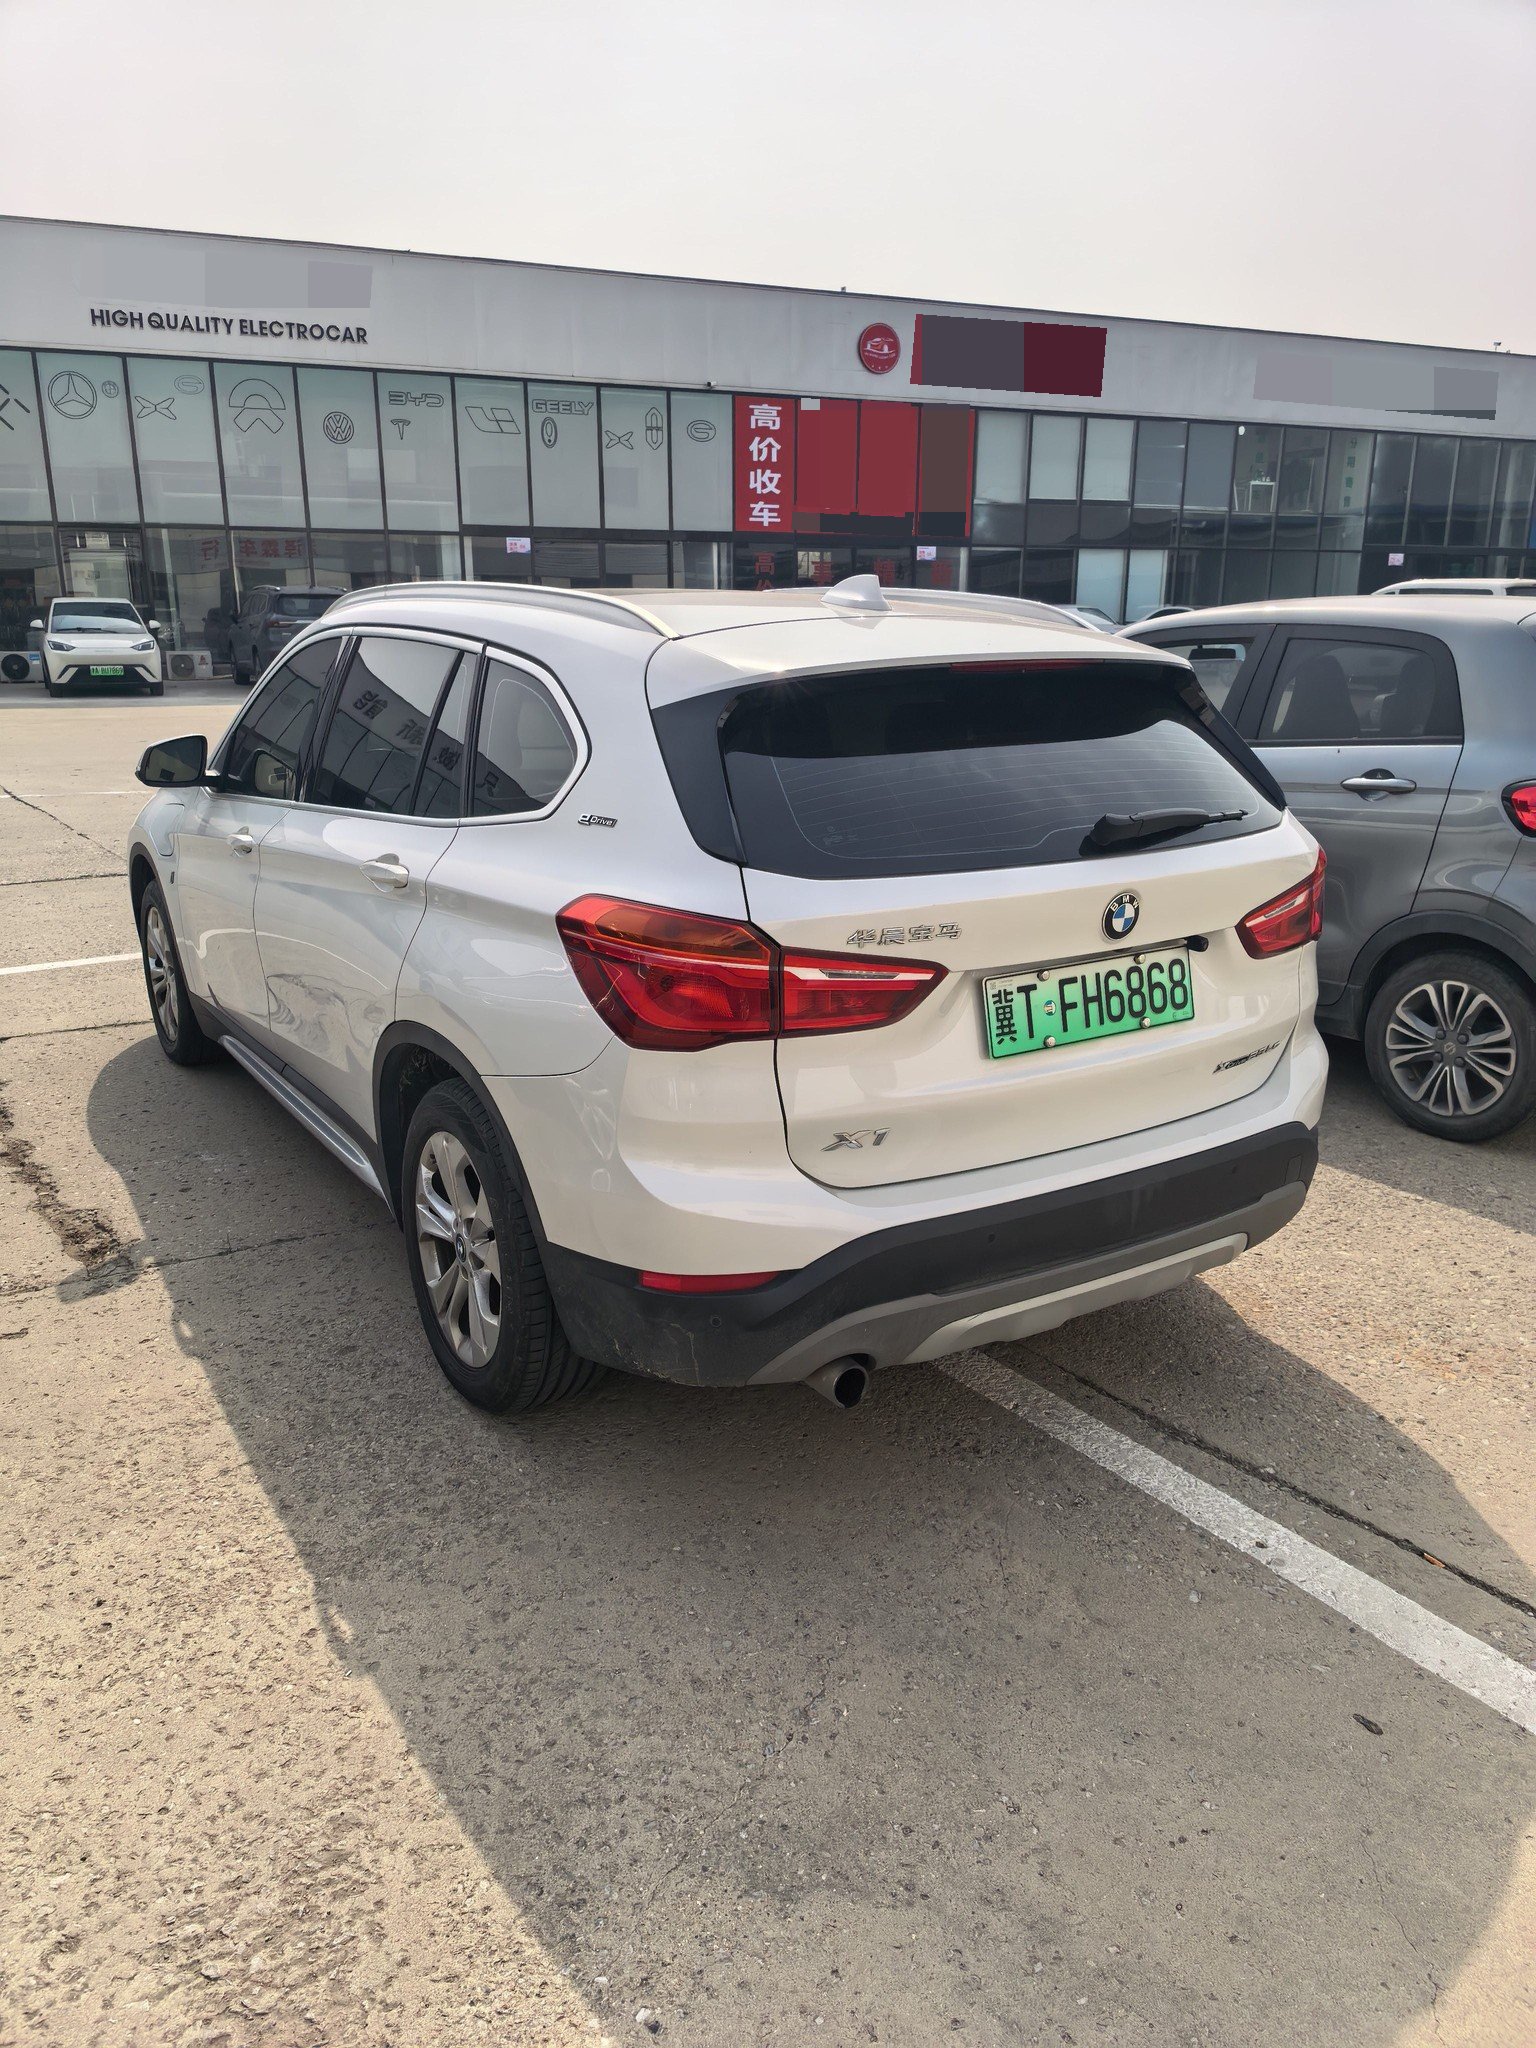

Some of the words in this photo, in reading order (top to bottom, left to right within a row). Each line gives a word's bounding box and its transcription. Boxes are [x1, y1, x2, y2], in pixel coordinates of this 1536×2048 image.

[90, 308, 144, 329] HIGH
[147, 312, 234, 335] QUALITY
[239, 318, 369, 345] ELECTROCAR
[531, 398, 595, 416] GEELY
[748, 403, 782, 527] 高价收车
[1110, 894, 1139, 912] BMW
[846, 922, 962, 948] 华晨宝马
[820, 1127, 891, 1152] X1
